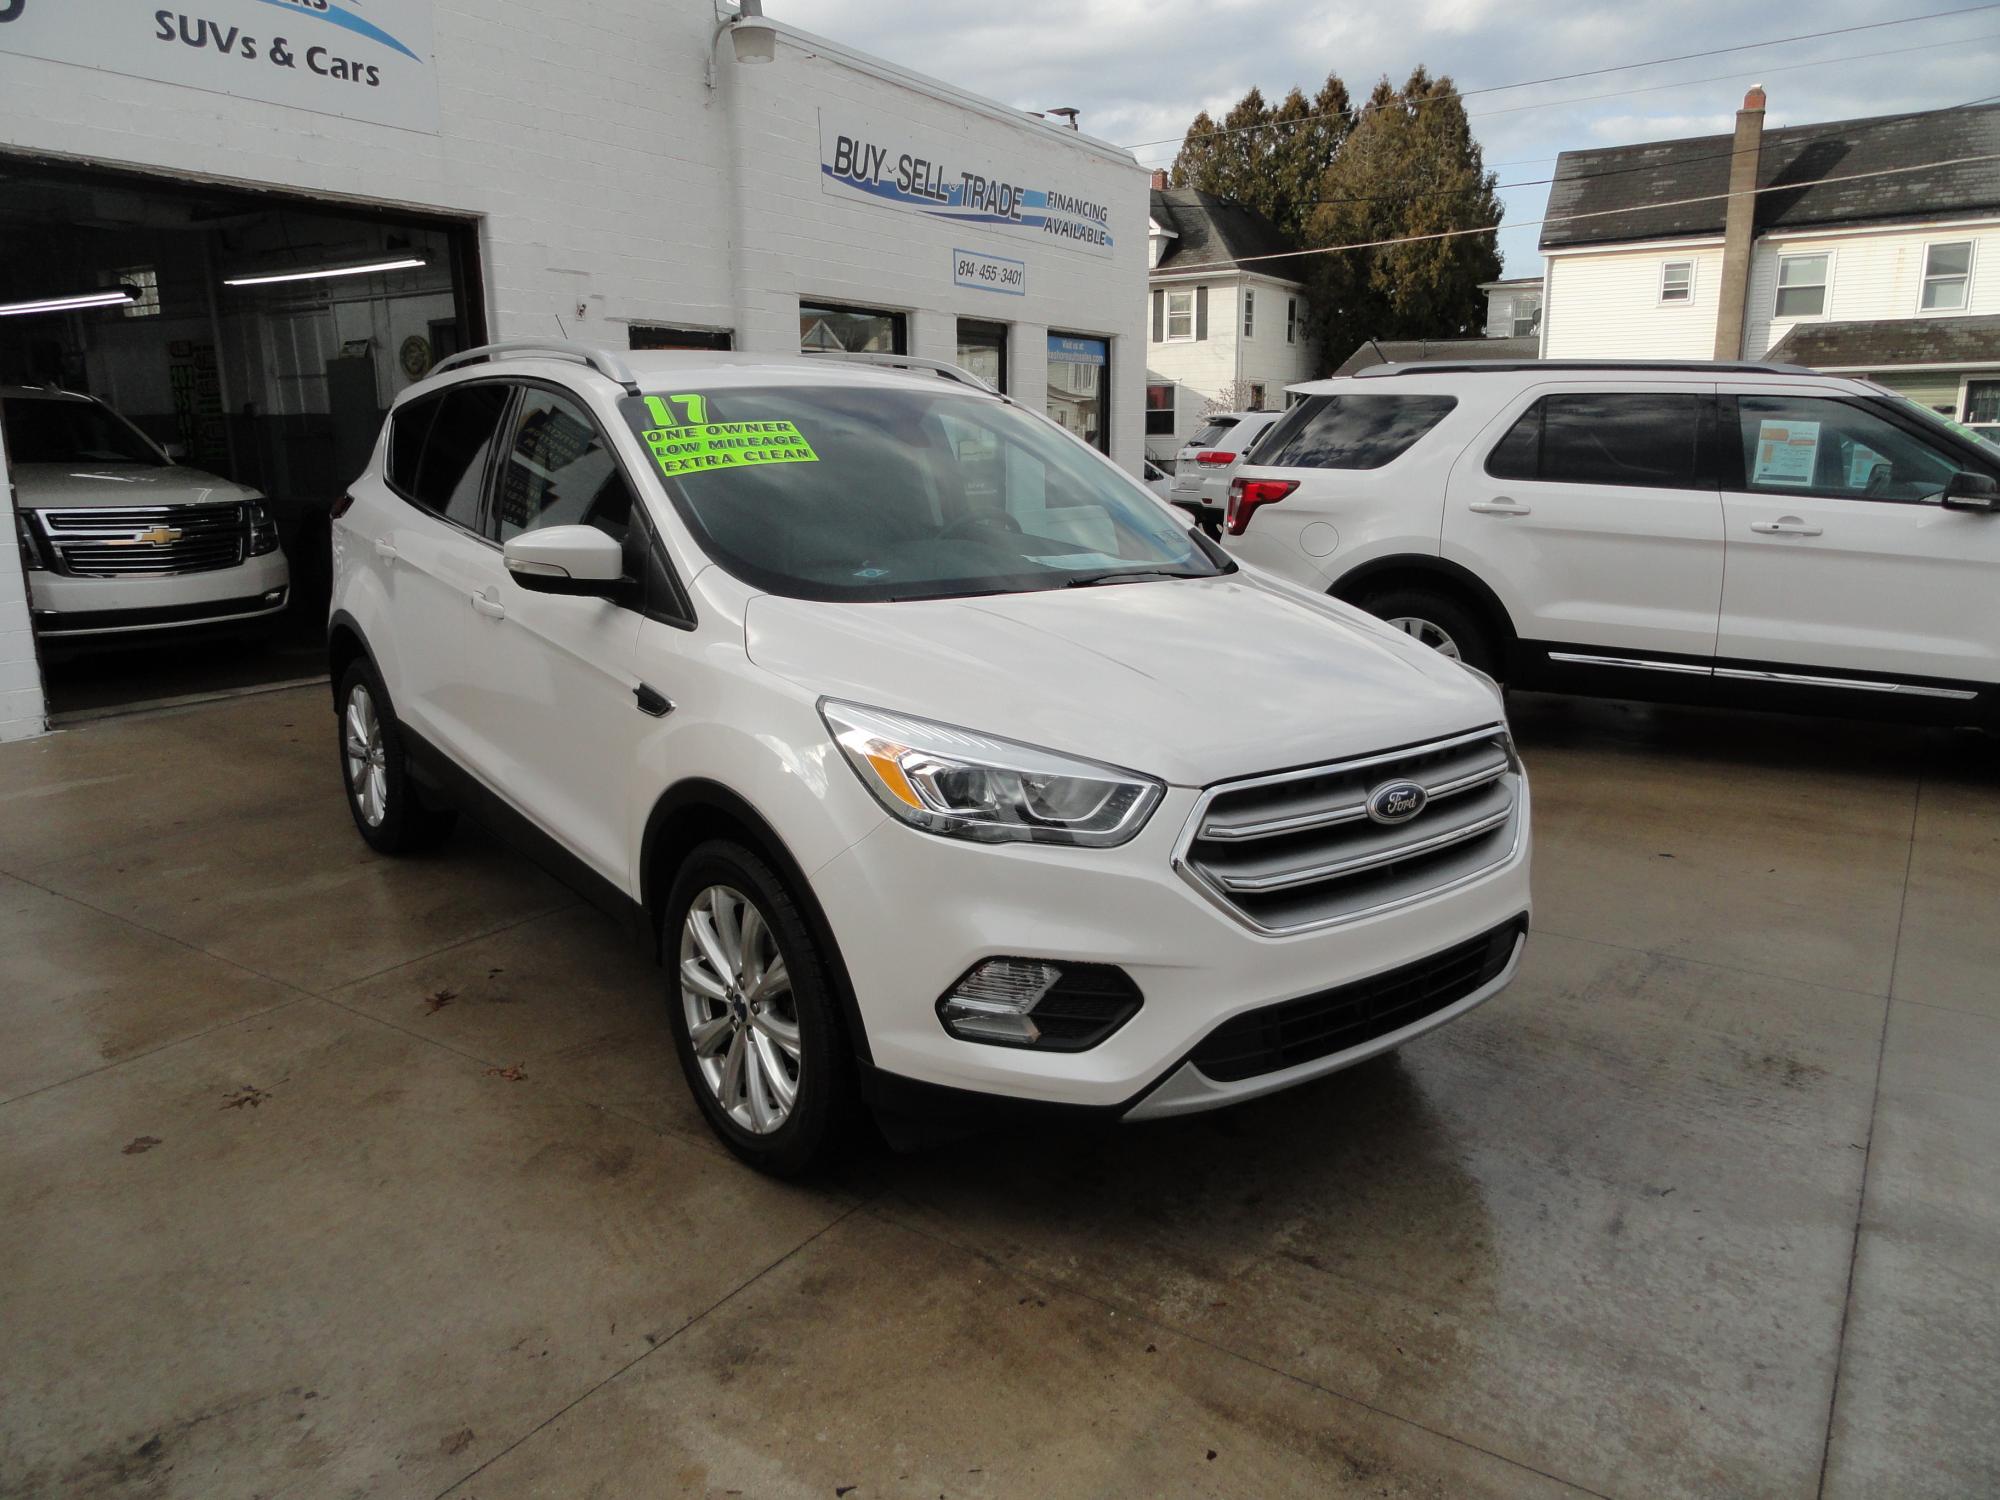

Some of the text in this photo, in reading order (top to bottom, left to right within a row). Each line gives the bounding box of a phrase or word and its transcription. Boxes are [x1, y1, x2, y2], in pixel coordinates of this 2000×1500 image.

[154, 10, 381, 87] SUVs & Cars
[833, 135, 1024, 220] BUY SELL TRADE
[1045, 190, 1108, 222] FINANCING
[1043, 217, 1106, 246] AVAILABLE
[643, 393, 709, 427] 17
[647, 422, 792, 443] ONE OWNER
[655, 435, 803, 457] LOW MILEAGE
[664, 448, 811, 472] EXTRA CLEAN
[1387, 790, 1417, 814] Ford
